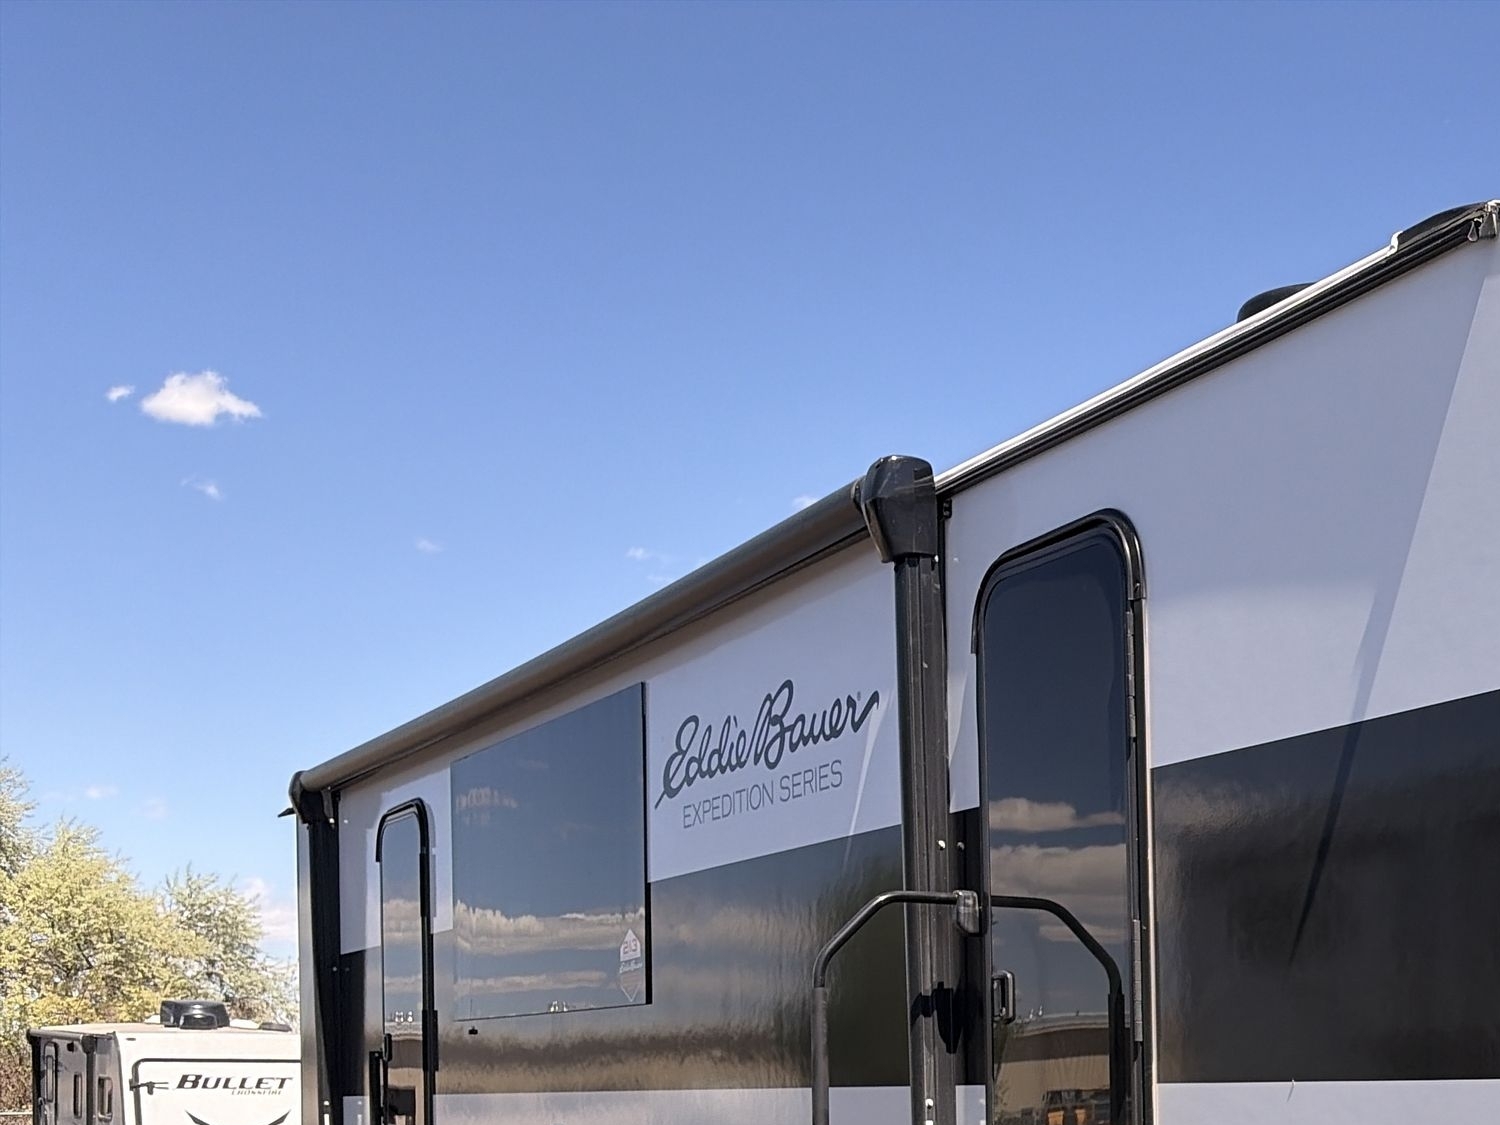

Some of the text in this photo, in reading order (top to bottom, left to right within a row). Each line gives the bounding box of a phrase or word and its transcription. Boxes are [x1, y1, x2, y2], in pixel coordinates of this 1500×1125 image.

[655, 678, 880, 809] Eddie Bauer
[682, 759, 844, 829] EXPEDITION SERIES
[176, 1074, 293, 1090] BULLET
